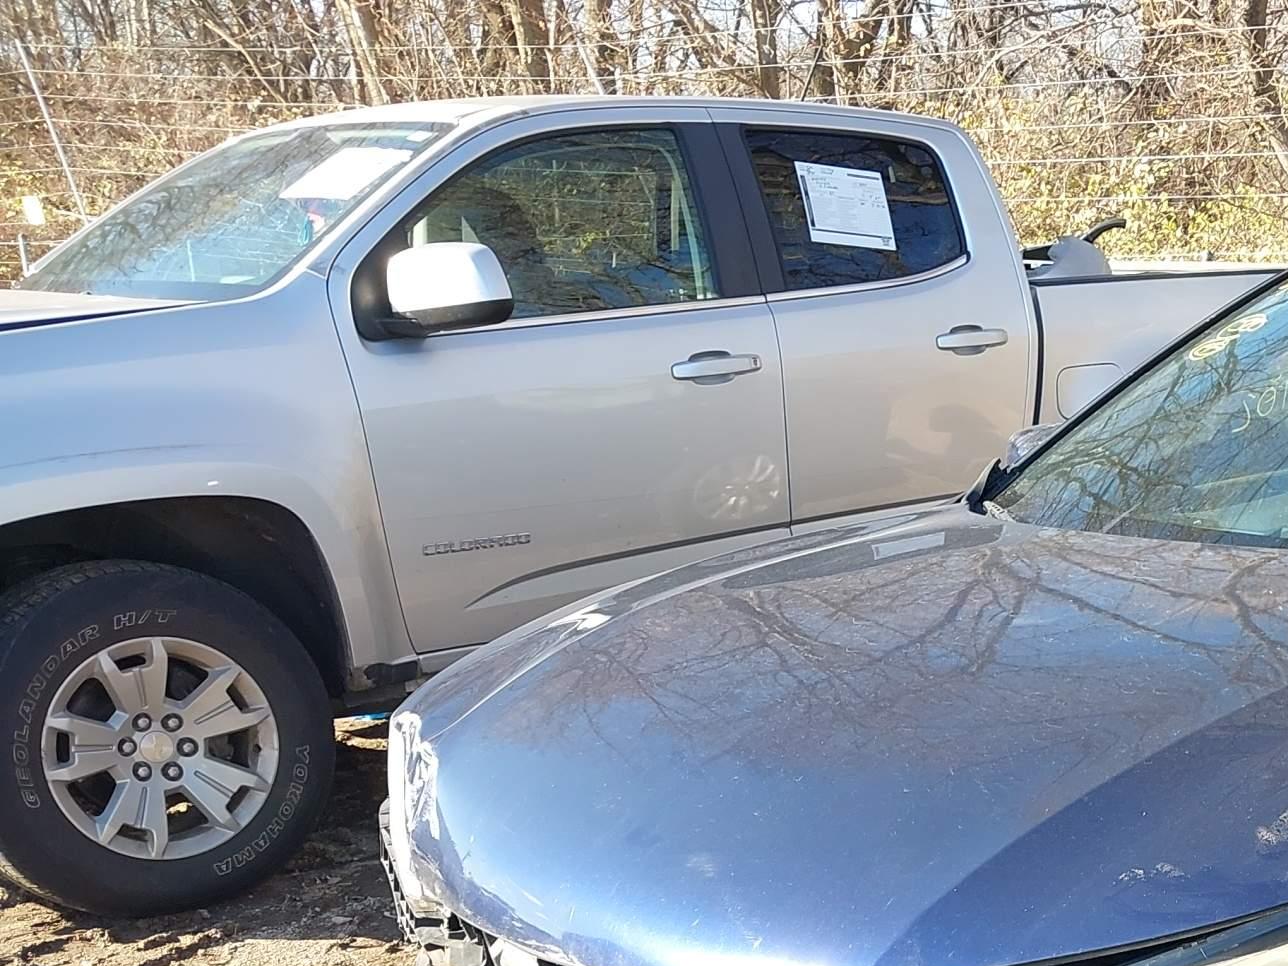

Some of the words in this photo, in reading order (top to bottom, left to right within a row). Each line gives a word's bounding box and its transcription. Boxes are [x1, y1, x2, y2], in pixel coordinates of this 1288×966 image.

[422, 531, 531, 556] COLORADO
[10, 622, 102, 809] GEOLANDAR
[112, 608, 177, 628] H/T
[213, 744, 312, 877] YOKOHAMA
